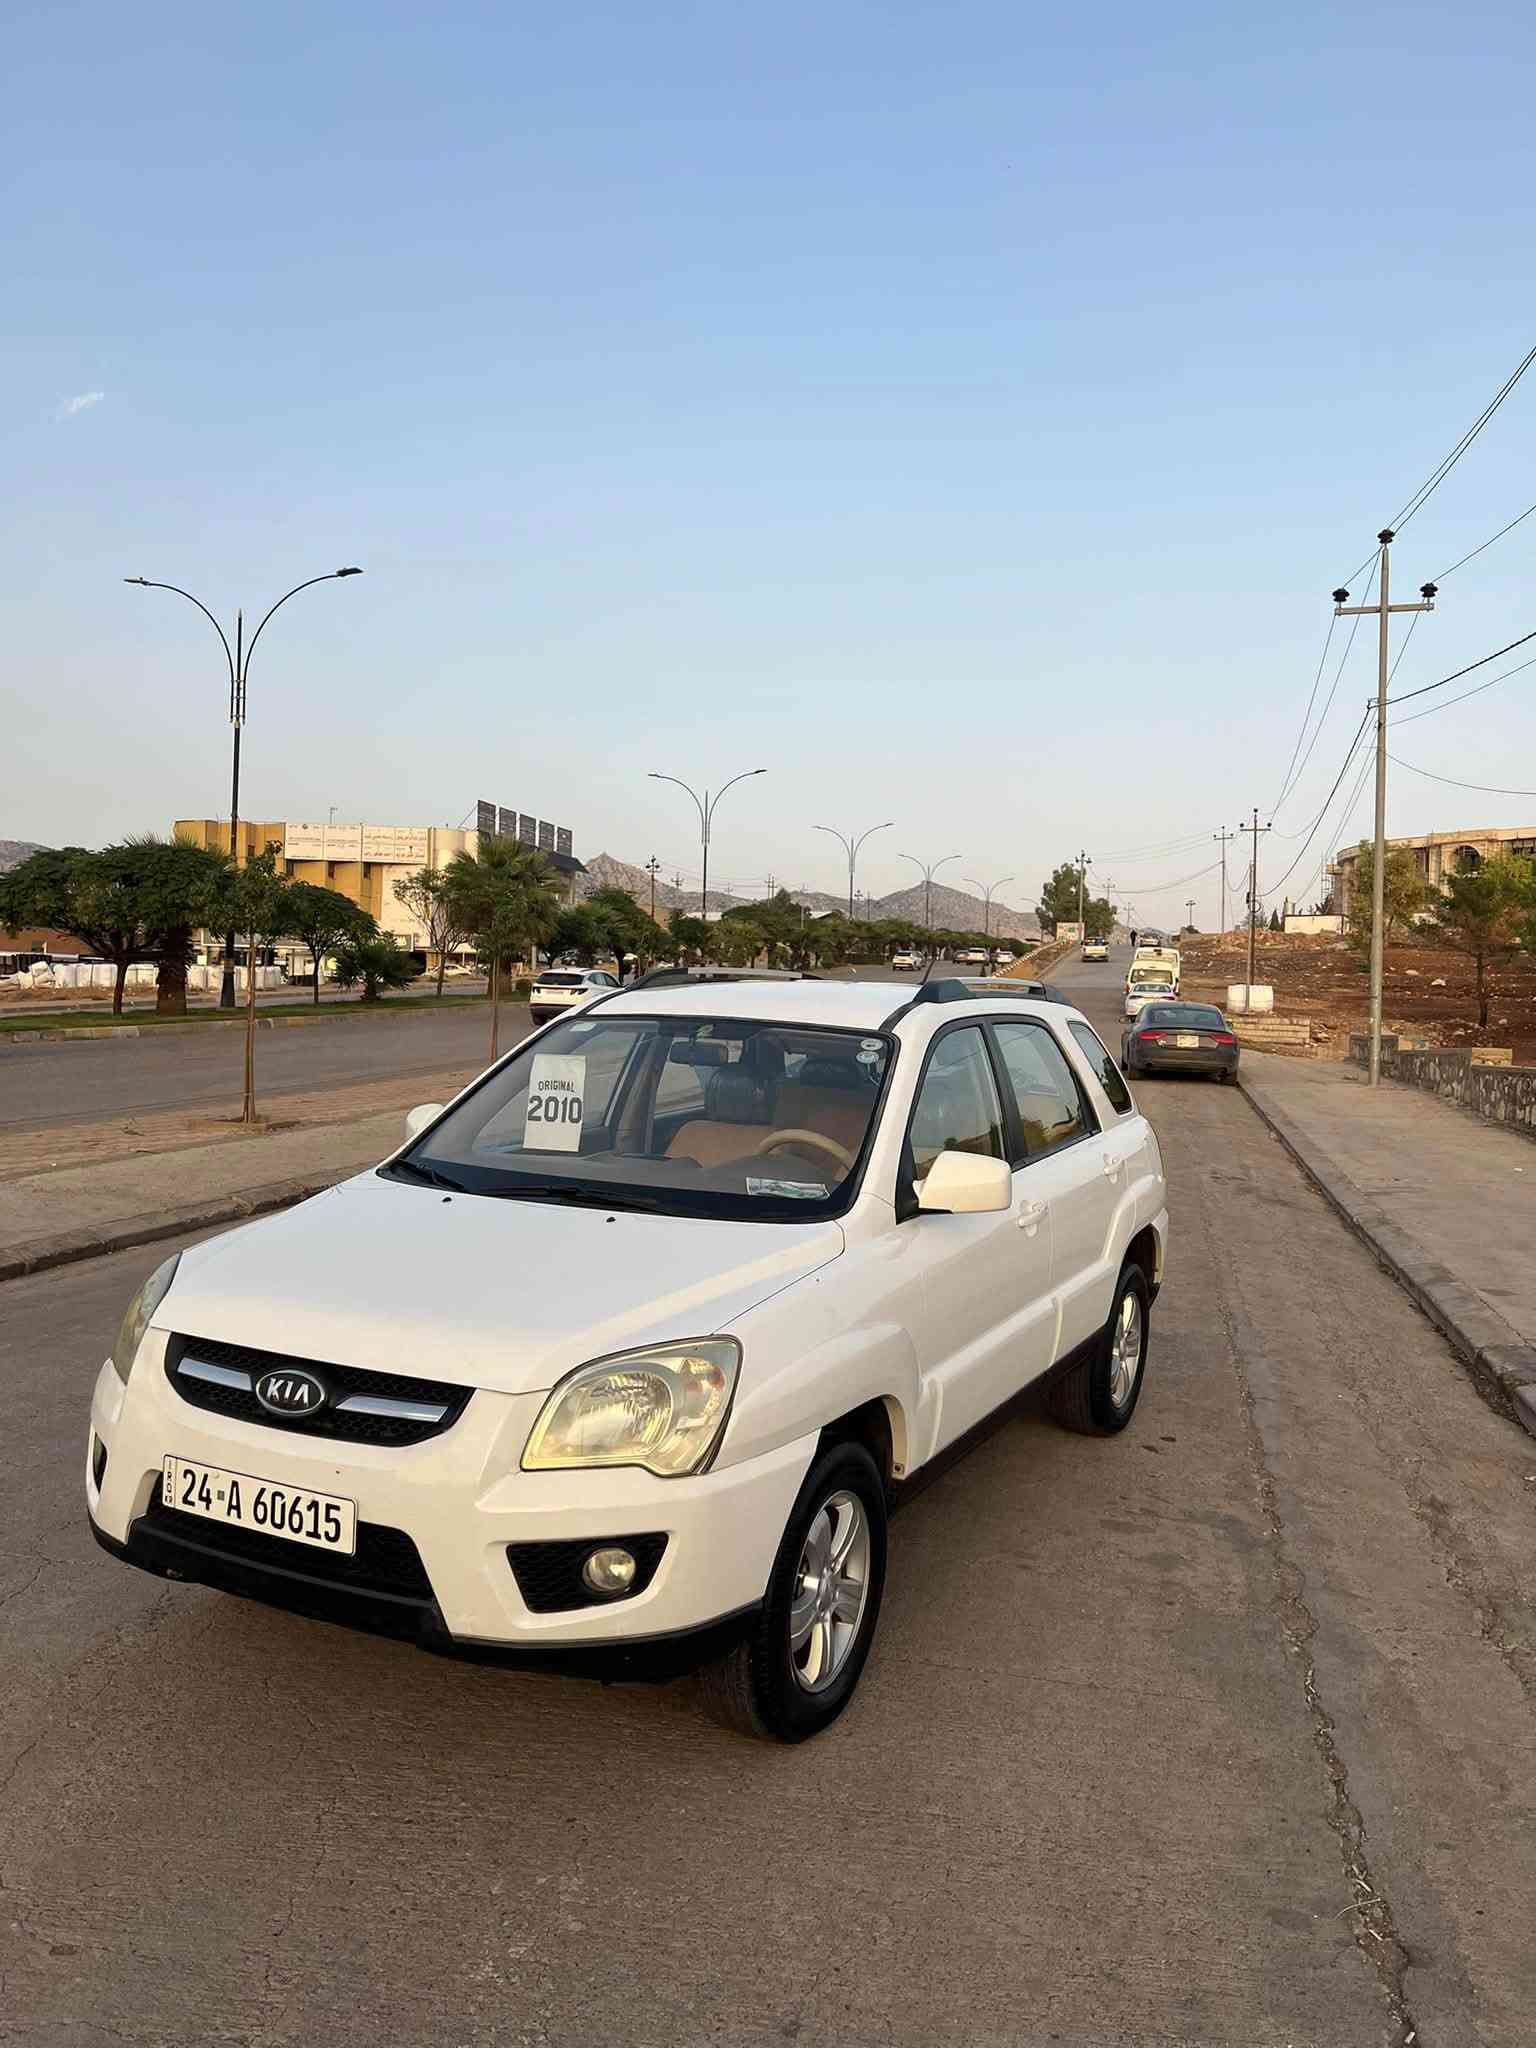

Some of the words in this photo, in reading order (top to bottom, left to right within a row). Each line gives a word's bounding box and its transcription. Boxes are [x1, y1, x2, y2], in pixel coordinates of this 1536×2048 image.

[538, 1080, 575, 1092] ORIGINAL
[528, 1095, 582, 1124] 2010
[266, 1377, 309, 1405] KIA
[182, 1469, 212, 1511] 24
[227, 1480, 241, 1519] A
[253, 1487, 341, 1543] 60615
